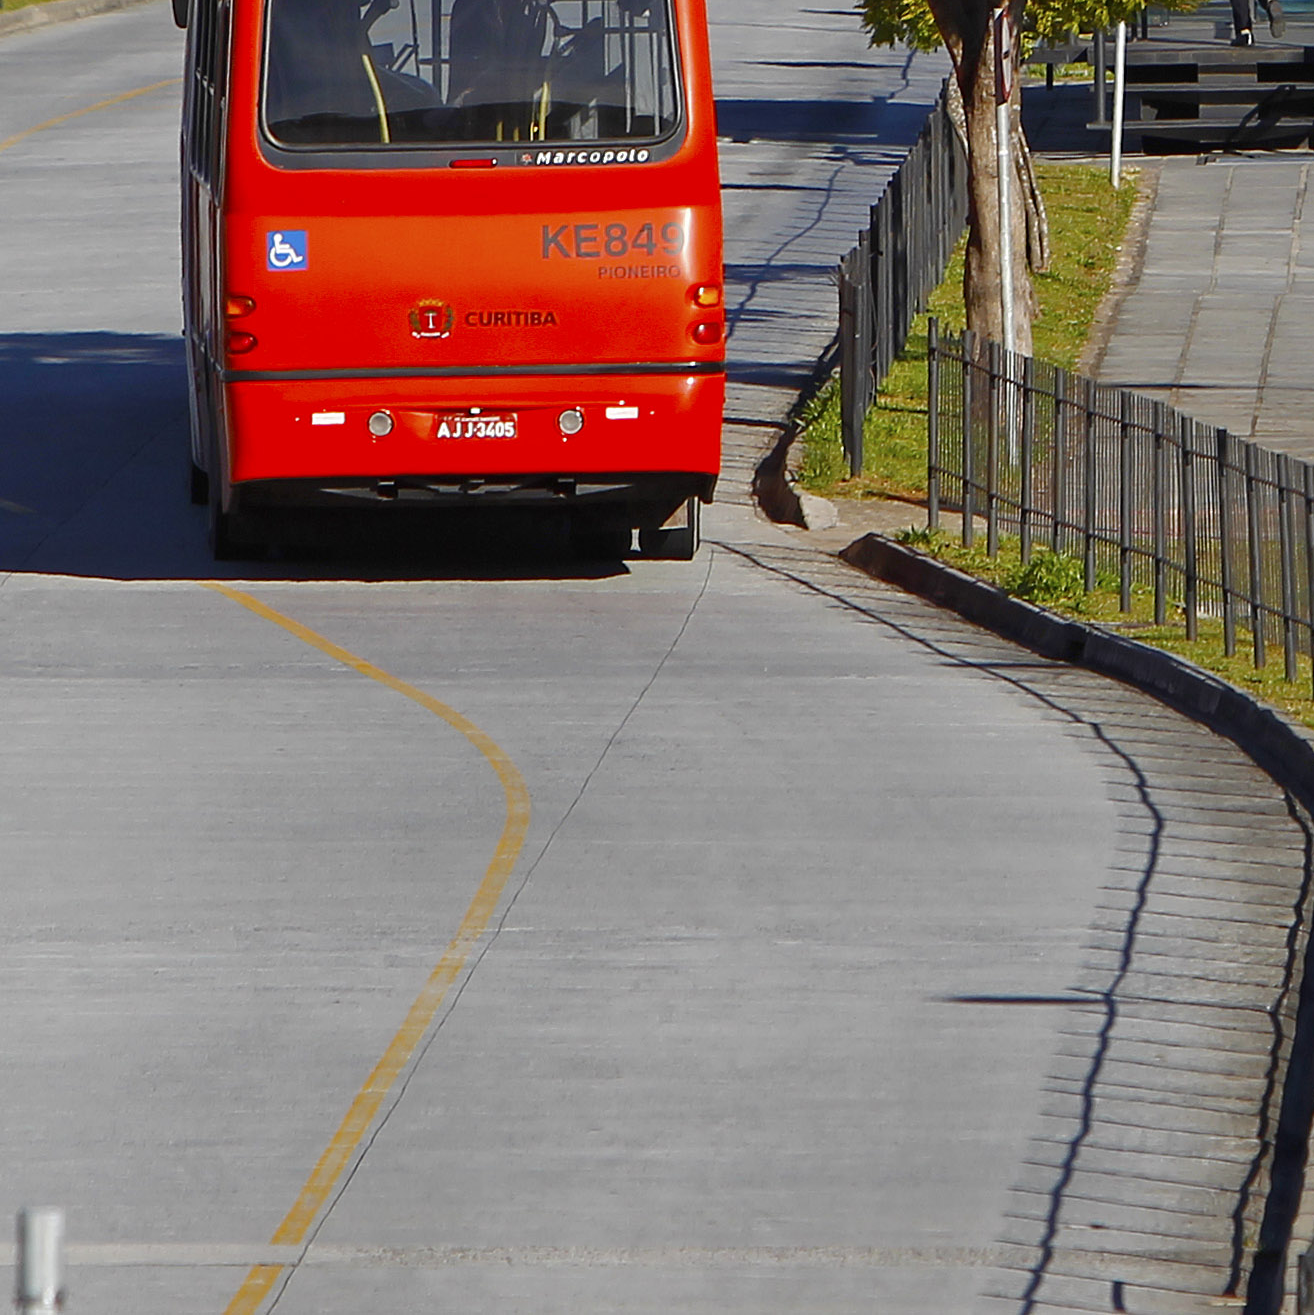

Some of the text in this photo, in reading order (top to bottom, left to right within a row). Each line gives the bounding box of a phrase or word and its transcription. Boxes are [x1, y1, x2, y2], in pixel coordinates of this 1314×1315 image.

[536, 148, 650, 166] Marcopolo
[541, 221, 685, 260] KE849
[597, 265, 681, 280] PIONEIRO
[464, 310, 558, 328] CURITIBA
[436, 421, 516, 439] AJJ-3405
